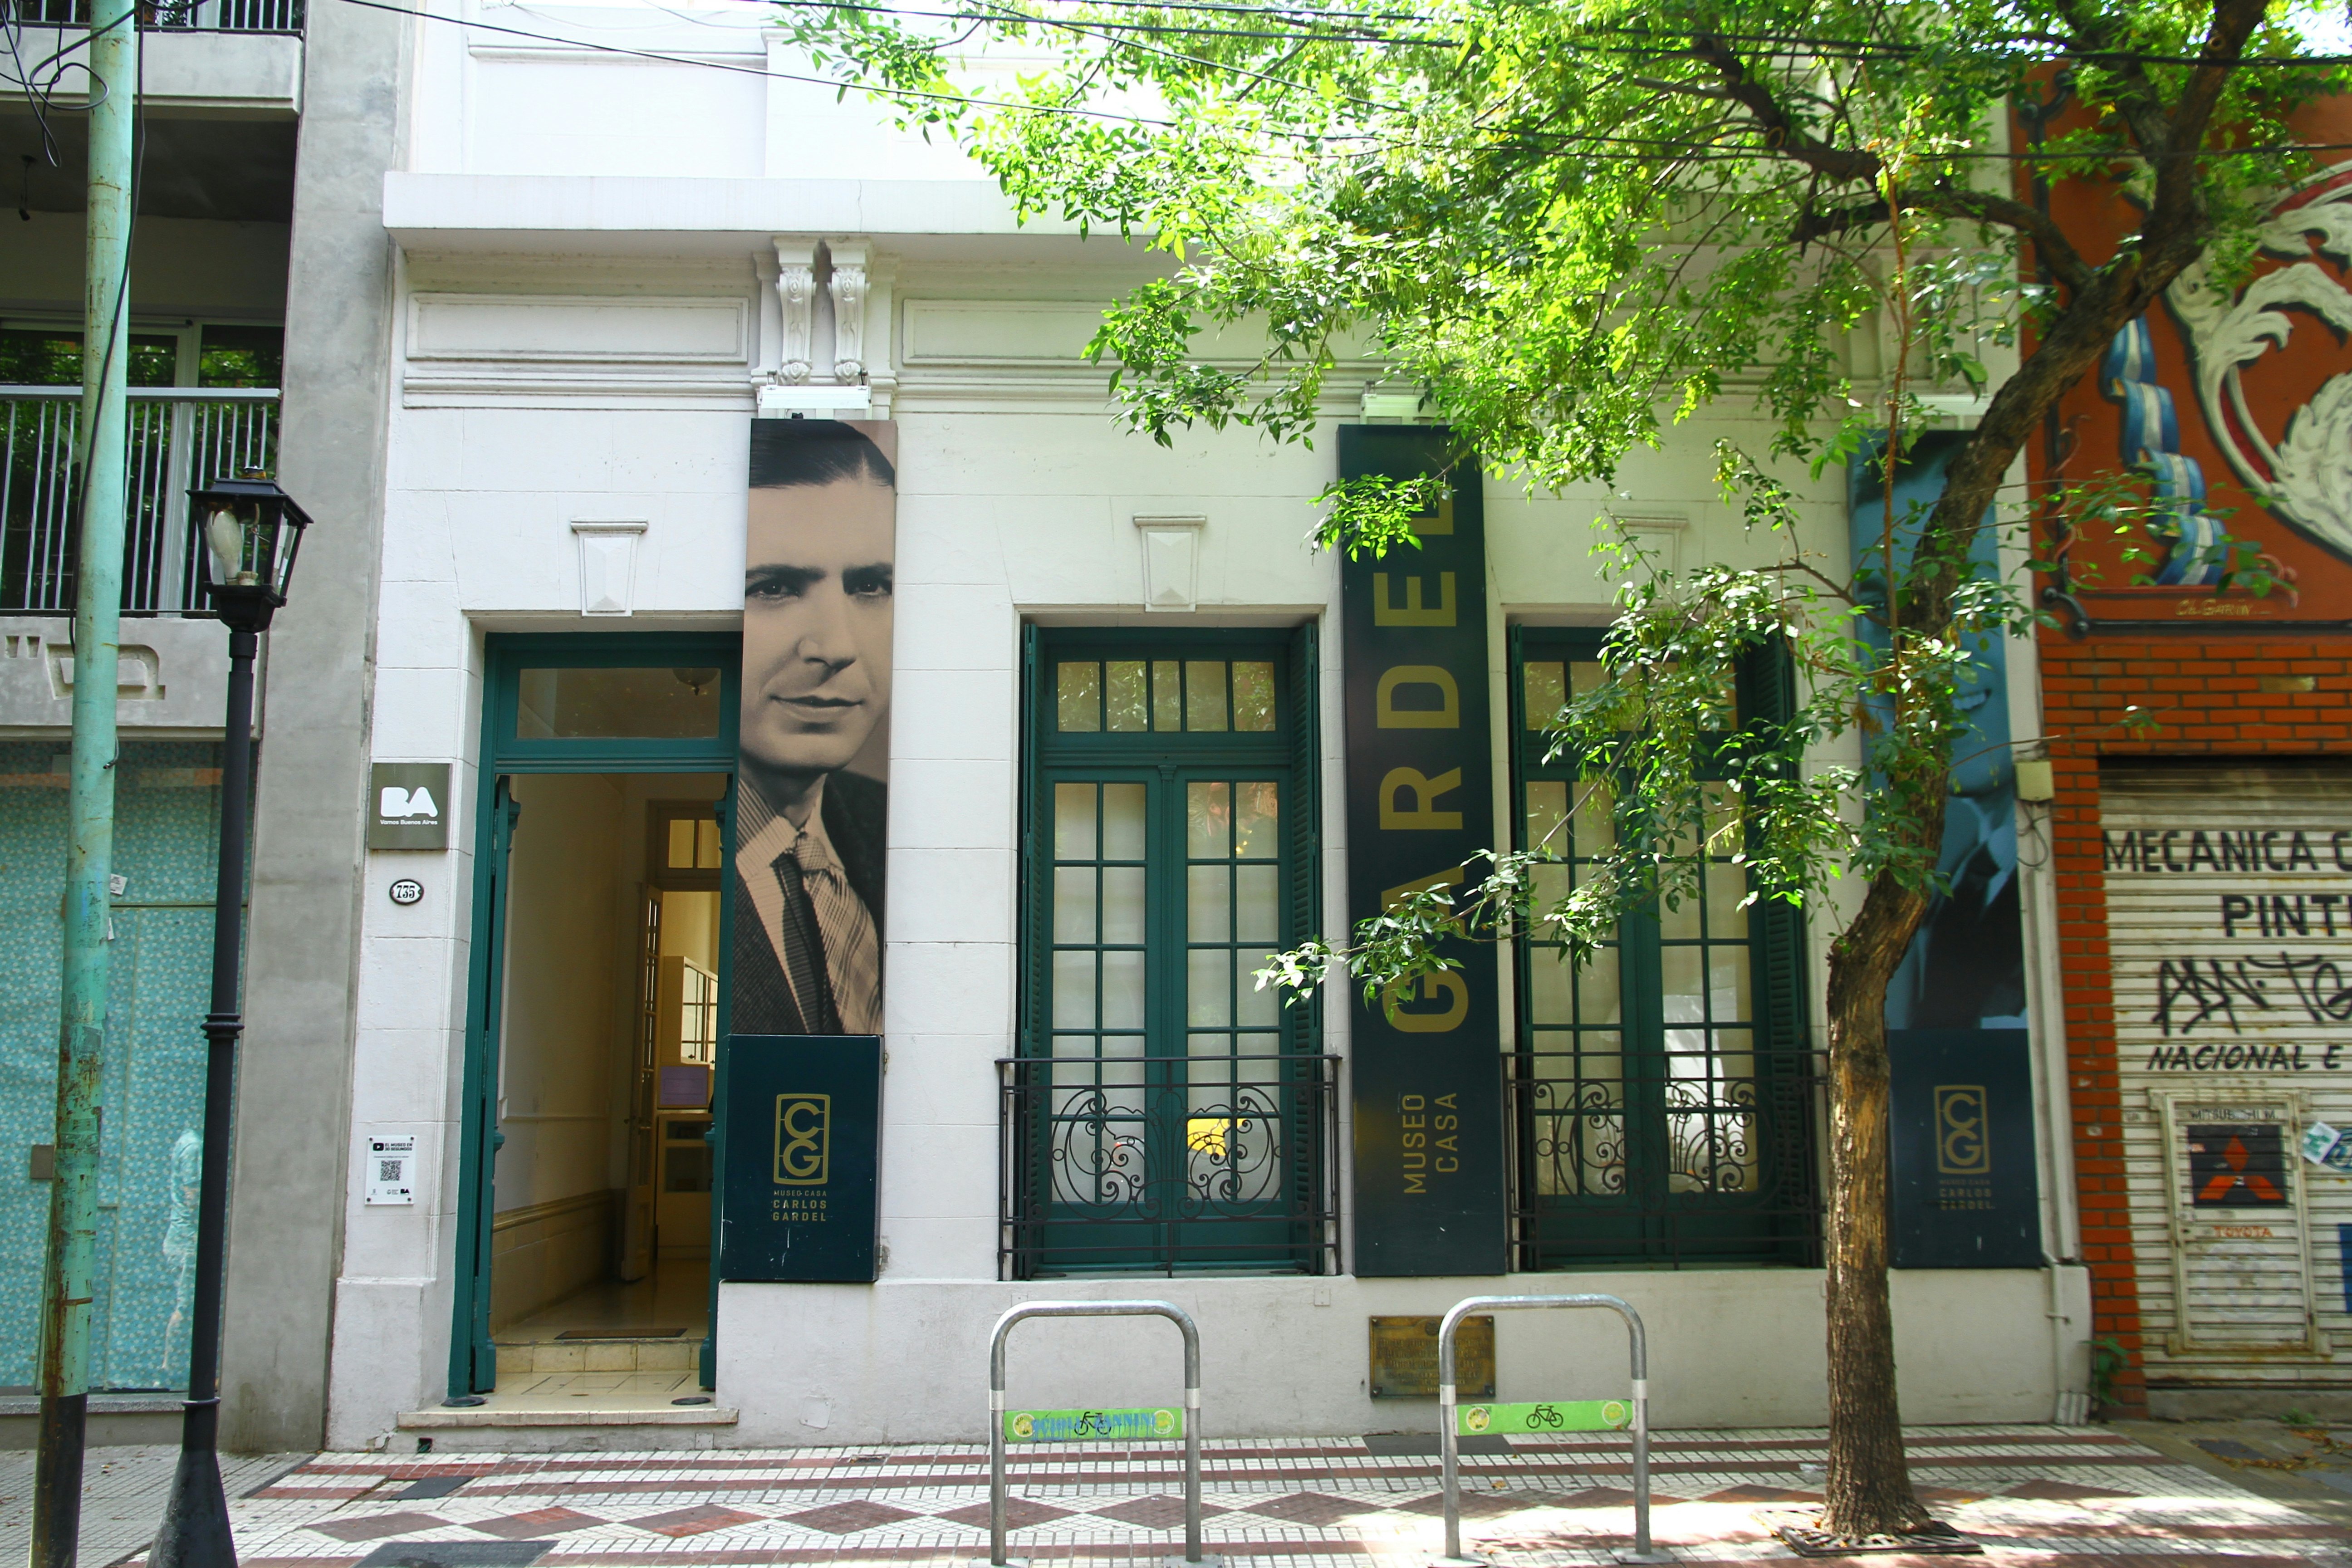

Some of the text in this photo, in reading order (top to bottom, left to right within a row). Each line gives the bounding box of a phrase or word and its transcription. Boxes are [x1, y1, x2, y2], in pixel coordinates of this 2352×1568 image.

[380, 786, 438, 817] BA
[2102, 830, 2320, 872] MECANICA
[396, 885, 415, 898] 735
[2223, 894, 2352, 937] PINT
[2148, 1045, 2310, 1070] NACIONAL
[1435, 1093, 1459, 1172] CASA
[1402, 1095, 1426, 1193] MUSEO
[1939, 1188, 1992, 1198] CARLOS
[773, 1199, 827, 1209] CARLOS
[1940, 1200, 1992, 1210] GARDEL
[773, 1212, 826, 1221] GARDEL
[2213, 1225, 2274, 1238] TOYOTA
